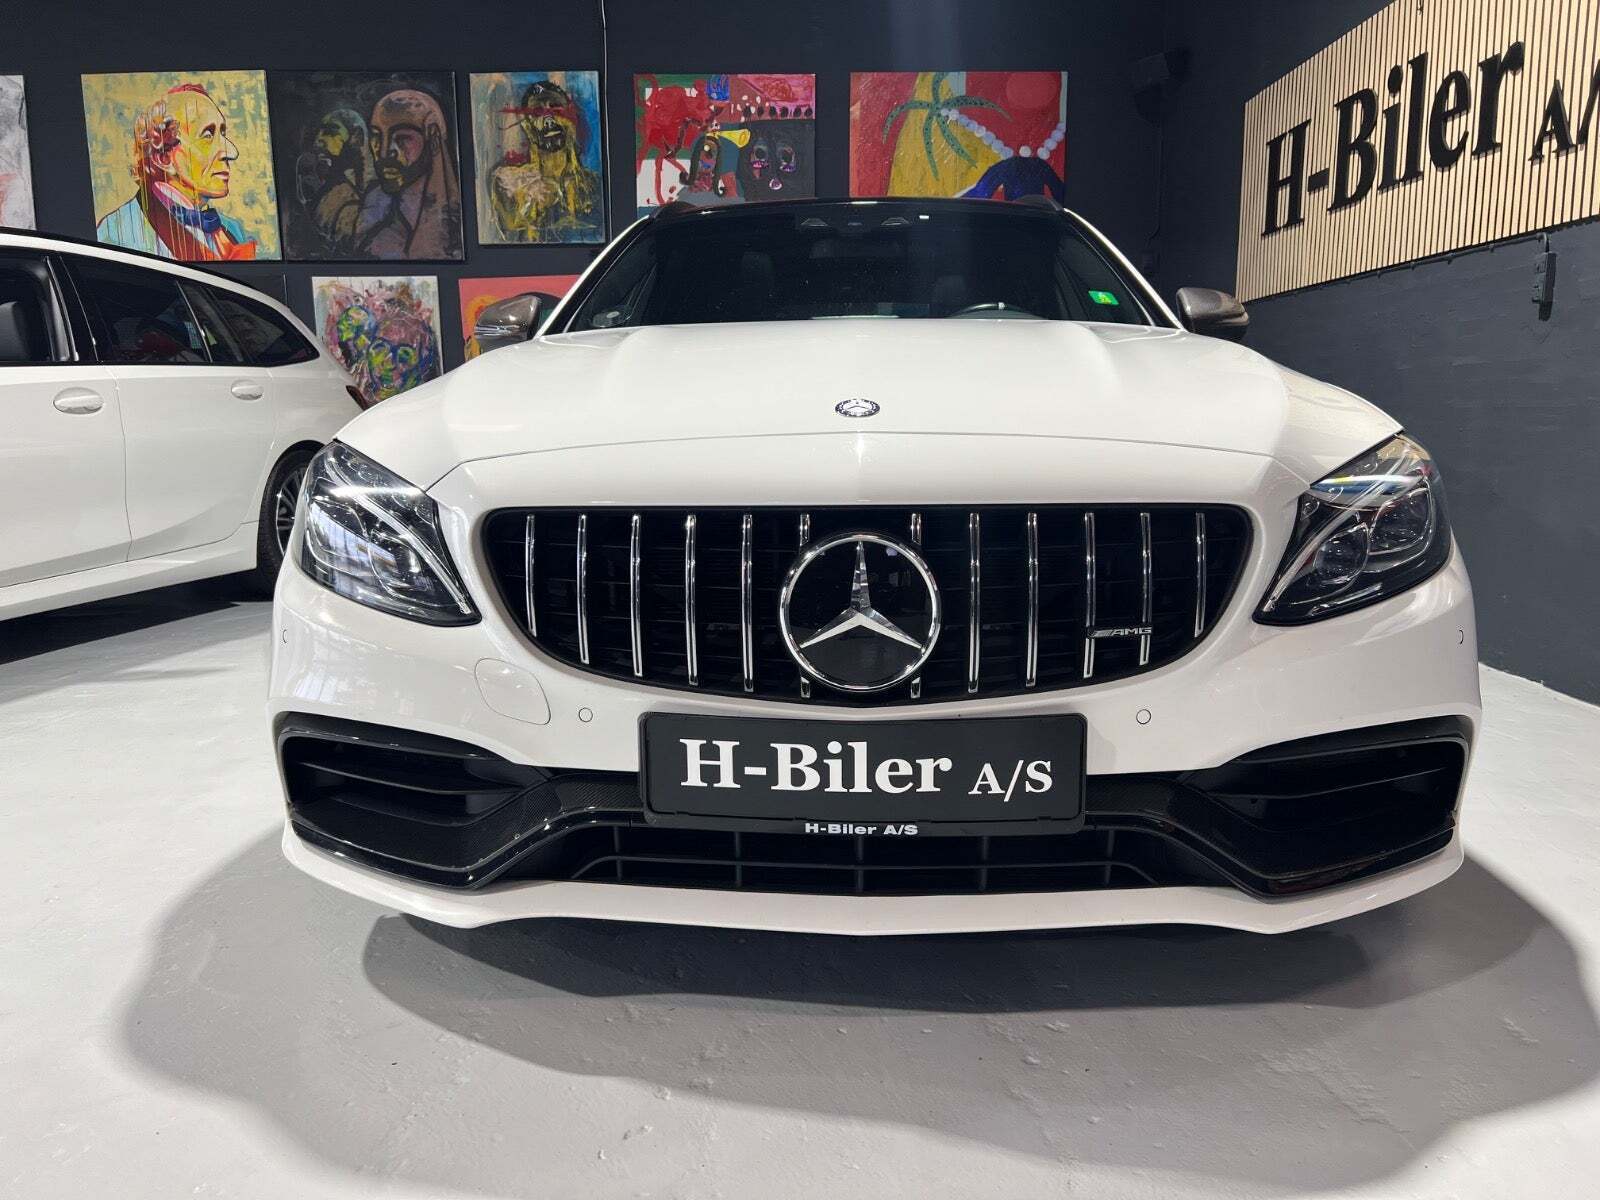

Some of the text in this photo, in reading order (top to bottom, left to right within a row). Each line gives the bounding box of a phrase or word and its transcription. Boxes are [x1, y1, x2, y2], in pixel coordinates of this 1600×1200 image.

[1262, 41, 1525, 236] H-Biler
[1111, 627, 1152, 636] AMG
[679, 738, 1053, 803] H-Biler A/S
[804, 822, 919, 836] H-Biler A/S
